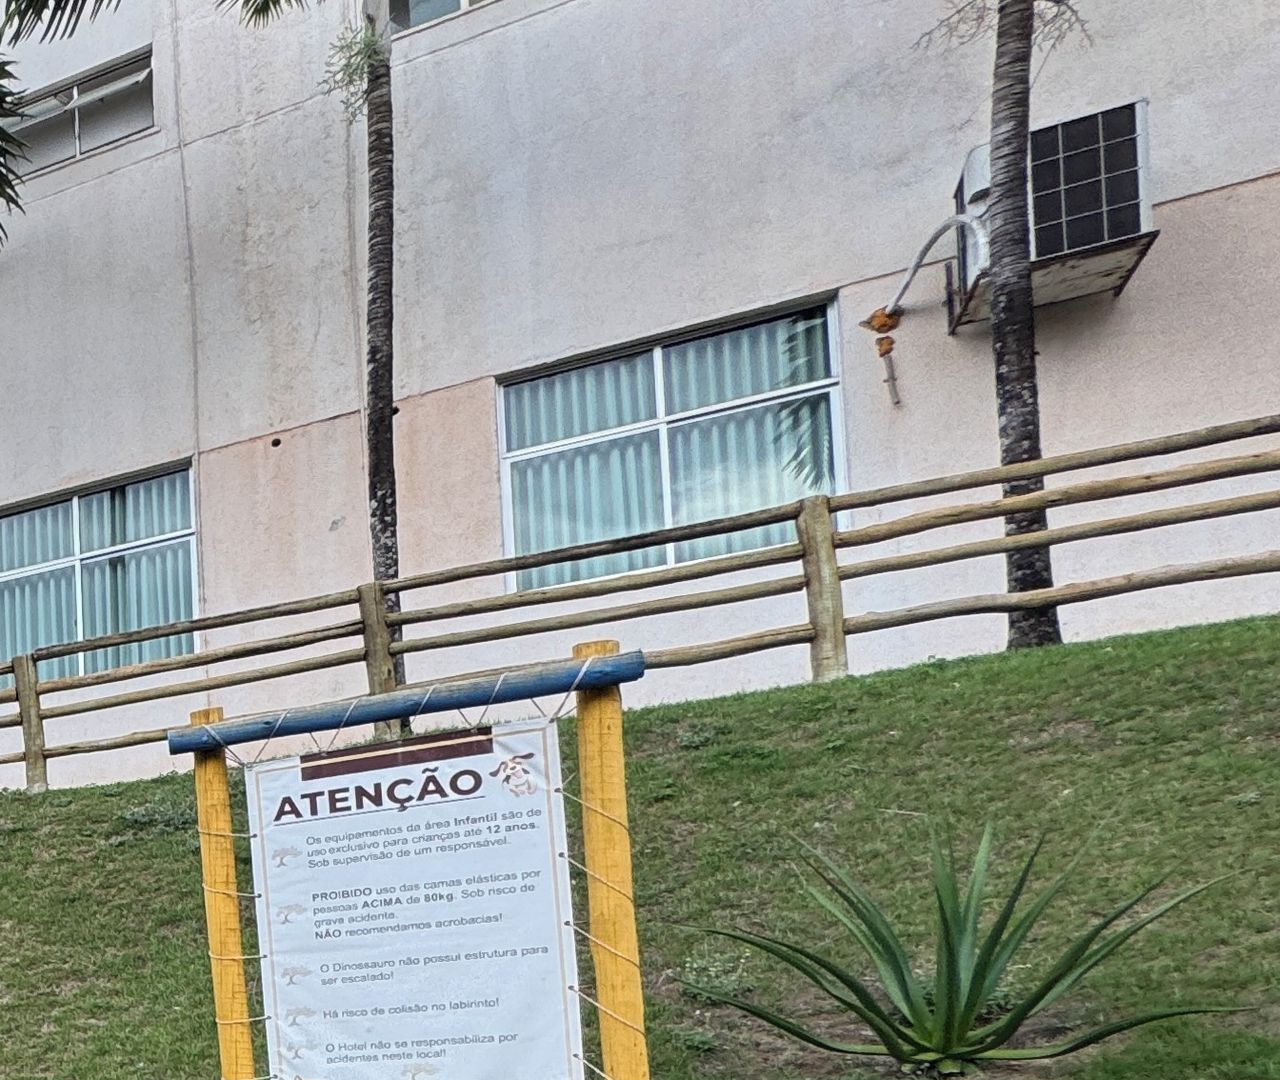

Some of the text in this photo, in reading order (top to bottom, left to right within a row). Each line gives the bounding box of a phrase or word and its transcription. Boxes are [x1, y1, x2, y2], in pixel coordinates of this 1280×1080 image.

[273, 767, 482, 822] ATENÇÃO
[306, 836, 321, 845] Os
[325, 827, 403, 843] equipamentos
[425, 819, 450, 830] área
[454, 813, 497, 827] Infantil
[501, 811, 523, 821] são
[526, 808, 541, 817] de
[307, 848, 326, 857] uso
[329, 841, 379, 854] exclusivo
[384, 837, 408, 849] para
[412, 831, 460, 843] crianças
[464, 827, 482, 838] até
[487, 825, 501, 834] 12
[308, 859, 329, 868] Sob
[333, 850, 393, 866] supervisão
[397, 848, 411, 858] de
[414, 846, 431, 855] um
[312, 869, 541, 902] PROIBIDO uso das camas elásticas por
[313, 902, 358, 915] pessoas
[362, 897, 403, 908] ACIMA
[406, 896, 420, 904] de
[461, 888, 484, 898] Sob
[488, 886, 516, 896] risco
[520, 884, 534, 892] de
[314, 918, 344, 928] grave
[315, 913, 503, 940] NÃO recomendamos acrobacias!
[320, 946, 548, 973] O Dinossauro não possui estrutura para
[321, 972, 394, 985] ser escalado!
[323, 998, 499, 1019] Há risco de colisão no labirinto!
[325, 1033, 518, 1052] O Hotel não se responsabiliza por
[326, 1053, 378, 1064] acidentes
[382, 1051, 413, 1061] neste
